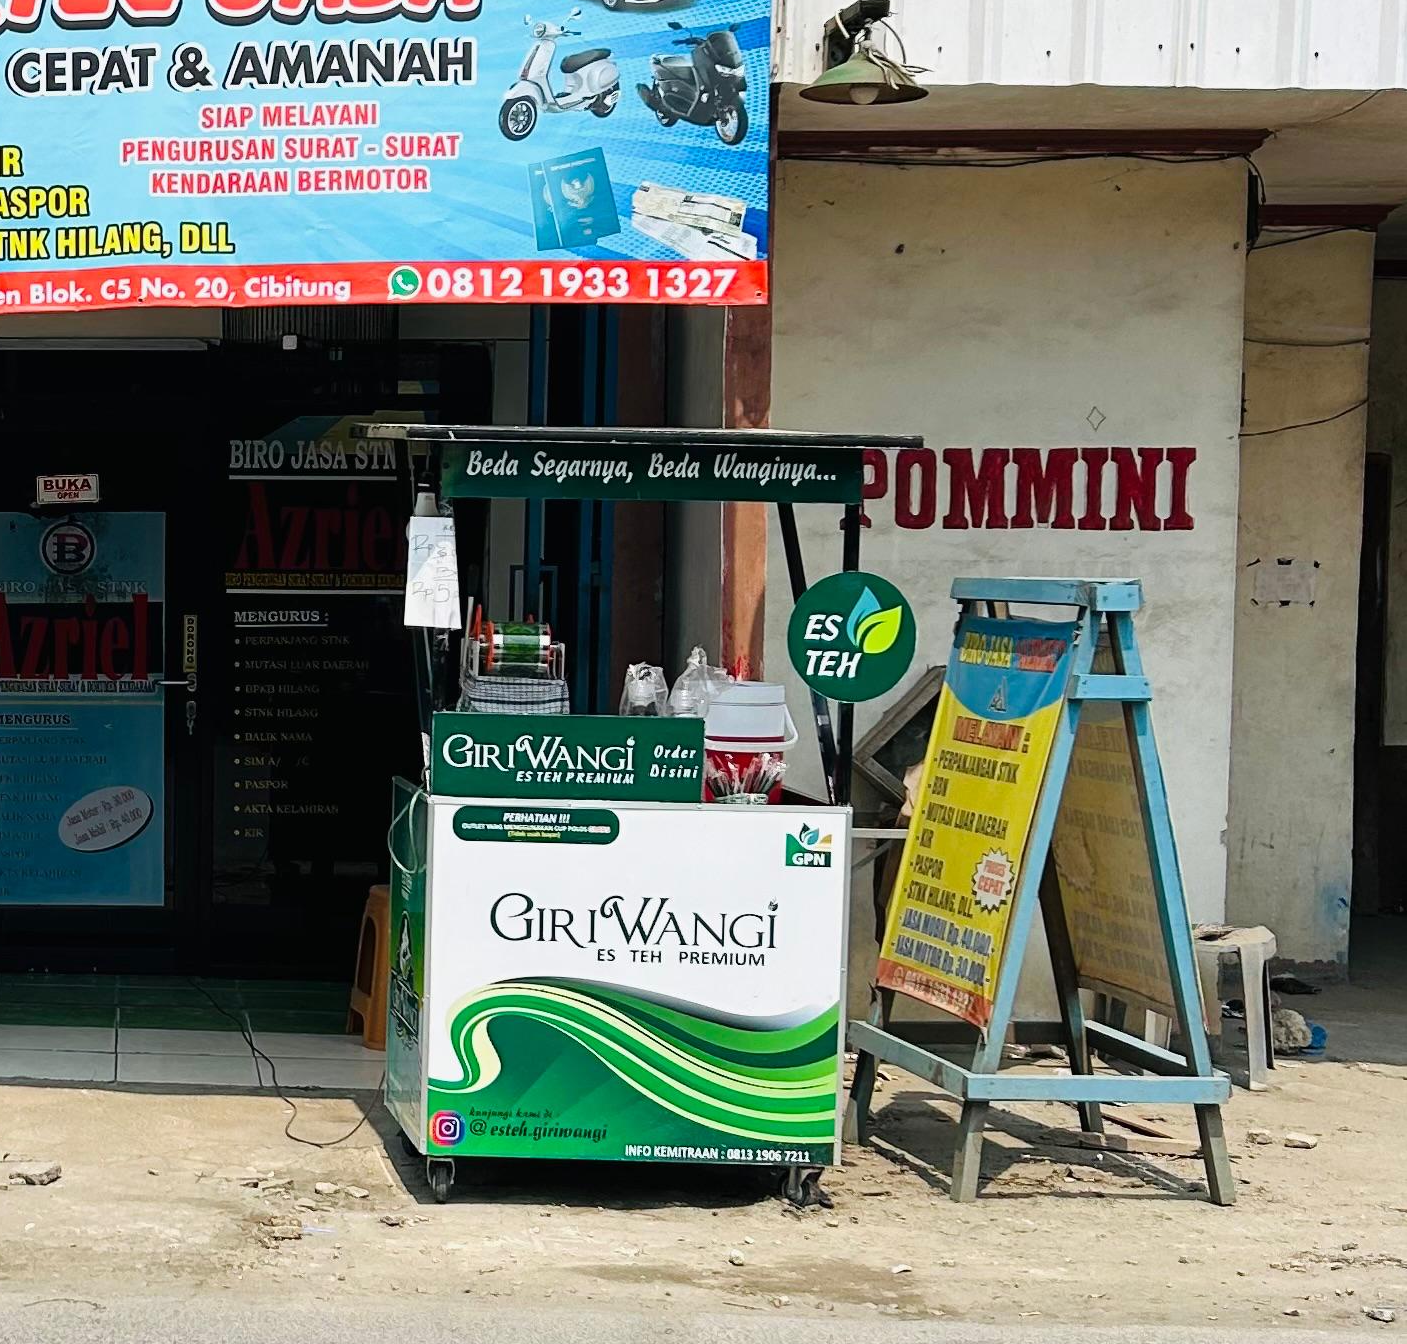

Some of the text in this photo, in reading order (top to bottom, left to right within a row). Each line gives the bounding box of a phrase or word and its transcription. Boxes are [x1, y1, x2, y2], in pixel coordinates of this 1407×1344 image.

[10, 46, 157, 97] CEPAT
[174, 46, 214, 89] &
[229, 42, 474, 86] AMANAH
[201, 104, 378, 129] SIAP MELAYANI
[122, 135, 461, 163] PENGURUSAN SURAT SURAT
[151, 168, 428, 194] KENDARAAN BERMOTOR
[56, 222, 171, 258] HILANG,
[180, 222, 235, 254] DLL
[29, 282, 92, 303] Blok.
[100, 278, 131, 300] C5
[140, 277, 186, 299] No.
[195, 277, 236, 302] 20,
[245, 275, 352, 302] Cibitung
[427, 266, 737, 298] 0812 1933 1327
[228, 439, 285, 469] BIRO
[291, 440, 348, 470] JASA
[466, 450, 837, 487] Beda Segarnya, Beda Wanginya...
[43, 478, 92, 491] BUKA
[234, 611, 320, 622] MENGURUS
[804, 614, 844, 642] ES
[805, 649, 863, 679] TEH
[244, 708, 274, 718] STNK
[653, 744, 697, 760] Order
[516, 771, 635, 784] ES TEH PREMIUM
[244, 805, 273, 814] AKTA
[503, 813, 557, 824] PERHATIAN
[791, 852, 826, 867] GPN
[597, 948, 766, 967] ES TEH PREMIUM
[625, 1144, 652, 1157] INFO
[654, 1146, 719, 1160] KEMITRAAN
[727, 1148, 753, 1160] 0813
[756, 1149, 782, 1162] 1906
